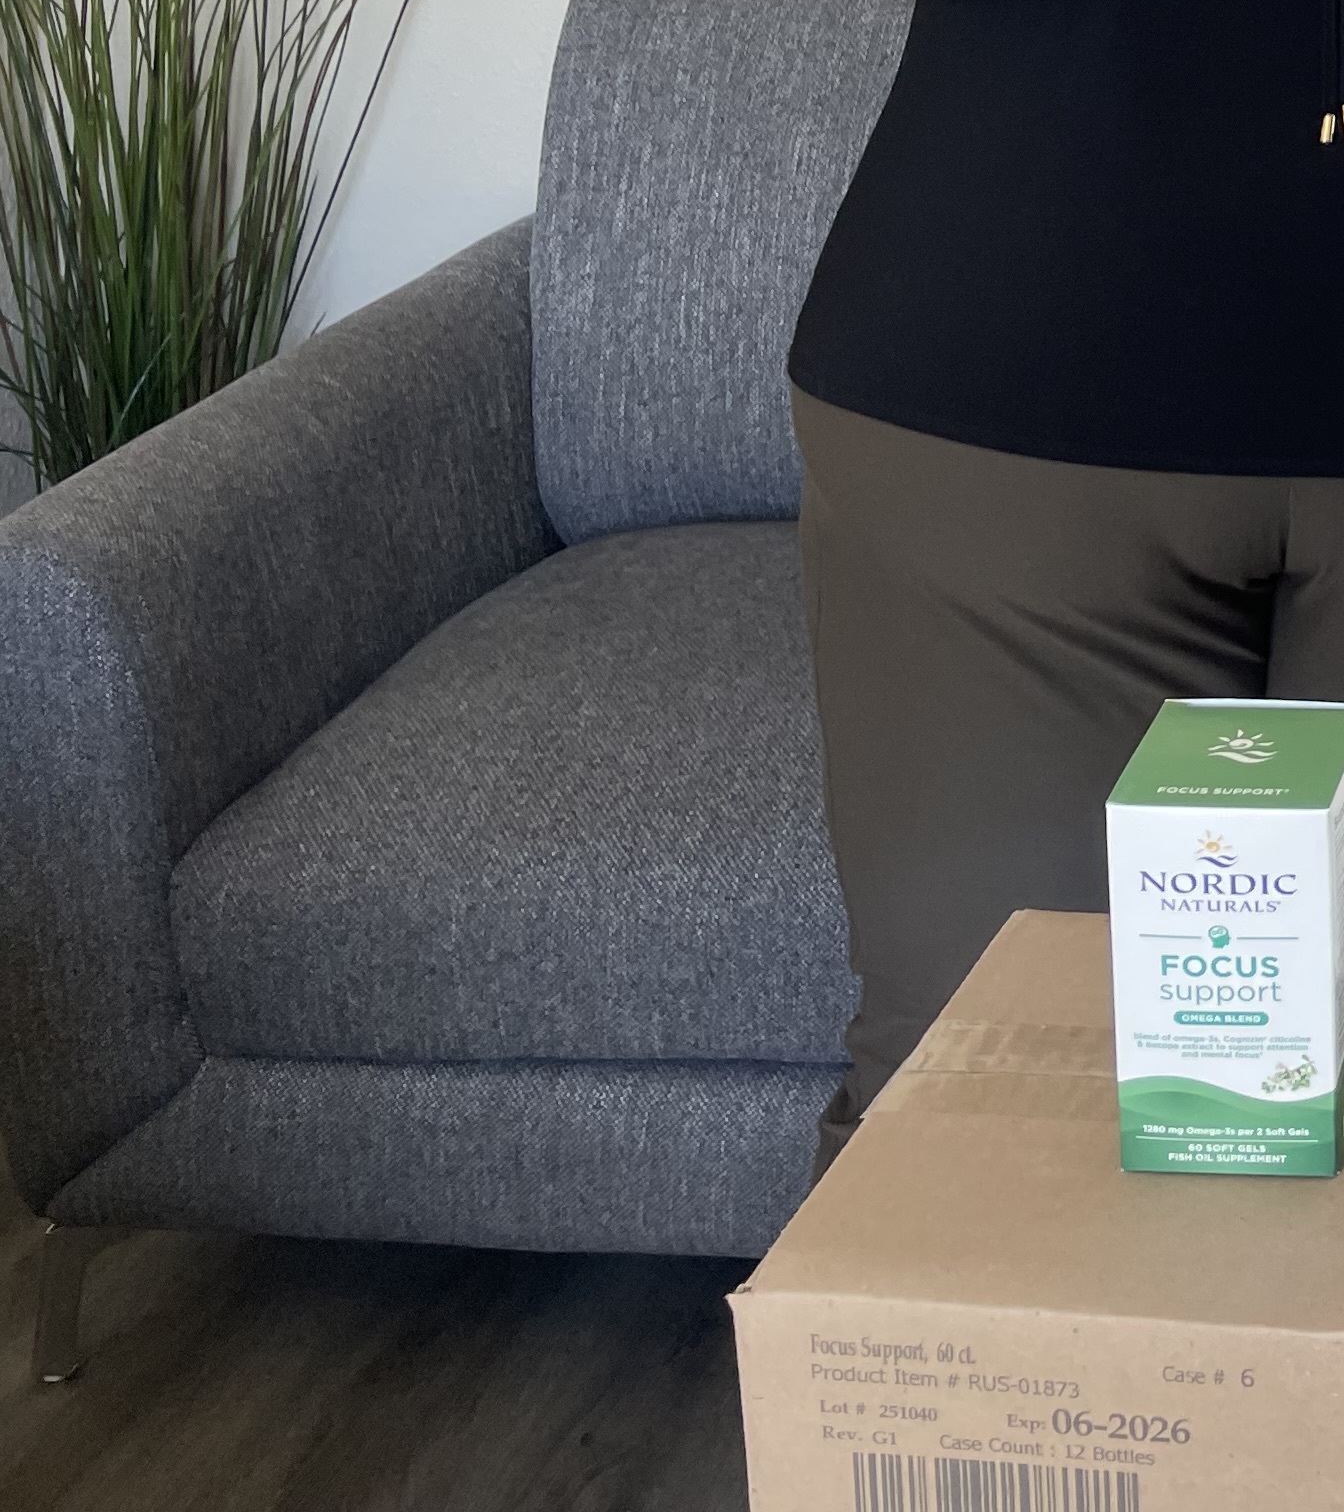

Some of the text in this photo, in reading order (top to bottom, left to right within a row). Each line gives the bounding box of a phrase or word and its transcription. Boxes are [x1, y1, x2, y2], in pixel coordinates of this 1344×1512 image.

[1157, 786, 1284, 796] FOCUS SUPPORT
[1139, 871, 1298, 896] NORDIC
[1161, 898, 1279, 913] NATURALS
[1161, 954, 1280, 978] FOCUS
[1159, 981, 1282, 1006] support
[1181, 1014, 1261, 1024] OMEGA BLEND
[1142, 1124, 1310, 1136] 1280 mg Omega-3s per 2 Soft Gels
[1168, 1153, 1287, 1164] FISH OIL SUPPLEMENT
[1188, 1144, 1266, 1153] 60 SOFT GELS
[810, 1333, 857, 1356] Focus
[860, 1337, 928, 1365] Support,
[936, 1342, 954, 1364] 60
[811, 1363, 1080, 1399] Product Item # RUS-01873
[1162, 1365, 1255, 1387] Case # 6
[820, 1399, 938, 1422] Lot # 251040
[822, 1425, 897, 1445] Rev. G1
[1006, 1408, 1191, 1444] Exp: 06-2026
[939, 1434, 1156, 1466] Case Count 12 Bottles
